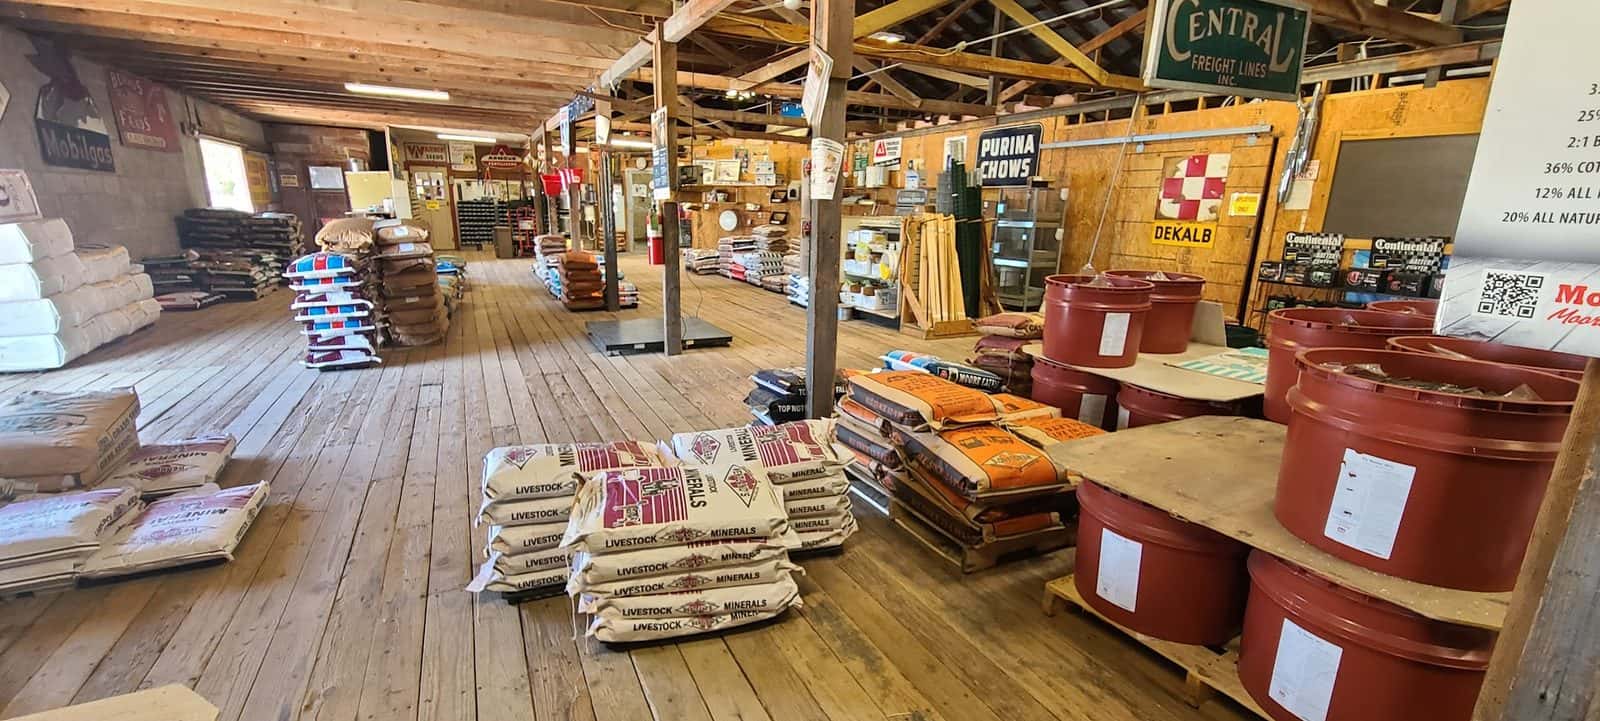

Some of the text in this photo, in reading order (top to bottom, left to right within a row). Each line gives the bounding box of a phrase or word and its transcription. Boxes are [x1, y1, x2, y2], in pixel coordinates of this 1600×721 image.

[1166, 0, 1296, 72] CENTRAL
[1192, 54, 1266, 78] FREIGHT LINES
[1218, 74, 1238, 86] INC.
[1589, 83, 1600, 95] 3
[42, 128, 112, 168] Mobilgas
[981, 134, 1035, 157] PURINA
[1567, 136, 1589, 148] 2:1
[981, 158, 1032, 179] CHOWS
[1544, 162, 1573, 174] 36%
[1535, 187, 1592, 199] 12% ALL
[1502, 211, 1529, 223] 20%
[1532, 212, 1555, 223] ALL
[1154, 225, 1212, 243] DEKALB
[1286, 233, 1342, 246] Continental
[1375, 239, 1439, 253] Continental
[778, 404, 791, 413] TOP
[516, 482, 563, 495] LIVESTOCK
[789, 486, 825, 497] MINERALS
[511, 508, 559, 521] LIVESTOCK
[789, 504, 825, 514] MINERALS
[794, 519, 830, 529] MINERALS
[523, 533, 564, 548] LIVESTOC
[605, 526, 757, 548] LIVESTOCK MINERALS
[617, 562, 668, 577] LIVESTOCK
[518, 574, 564, 588] LIVESTOCK
[614, 572, 760, 596] LIVESTOCK MINERALS
[622, 599, 767, 617] LIVESTOCK MINERALS
[633, 620, 682, 633] LIVESTOCK
